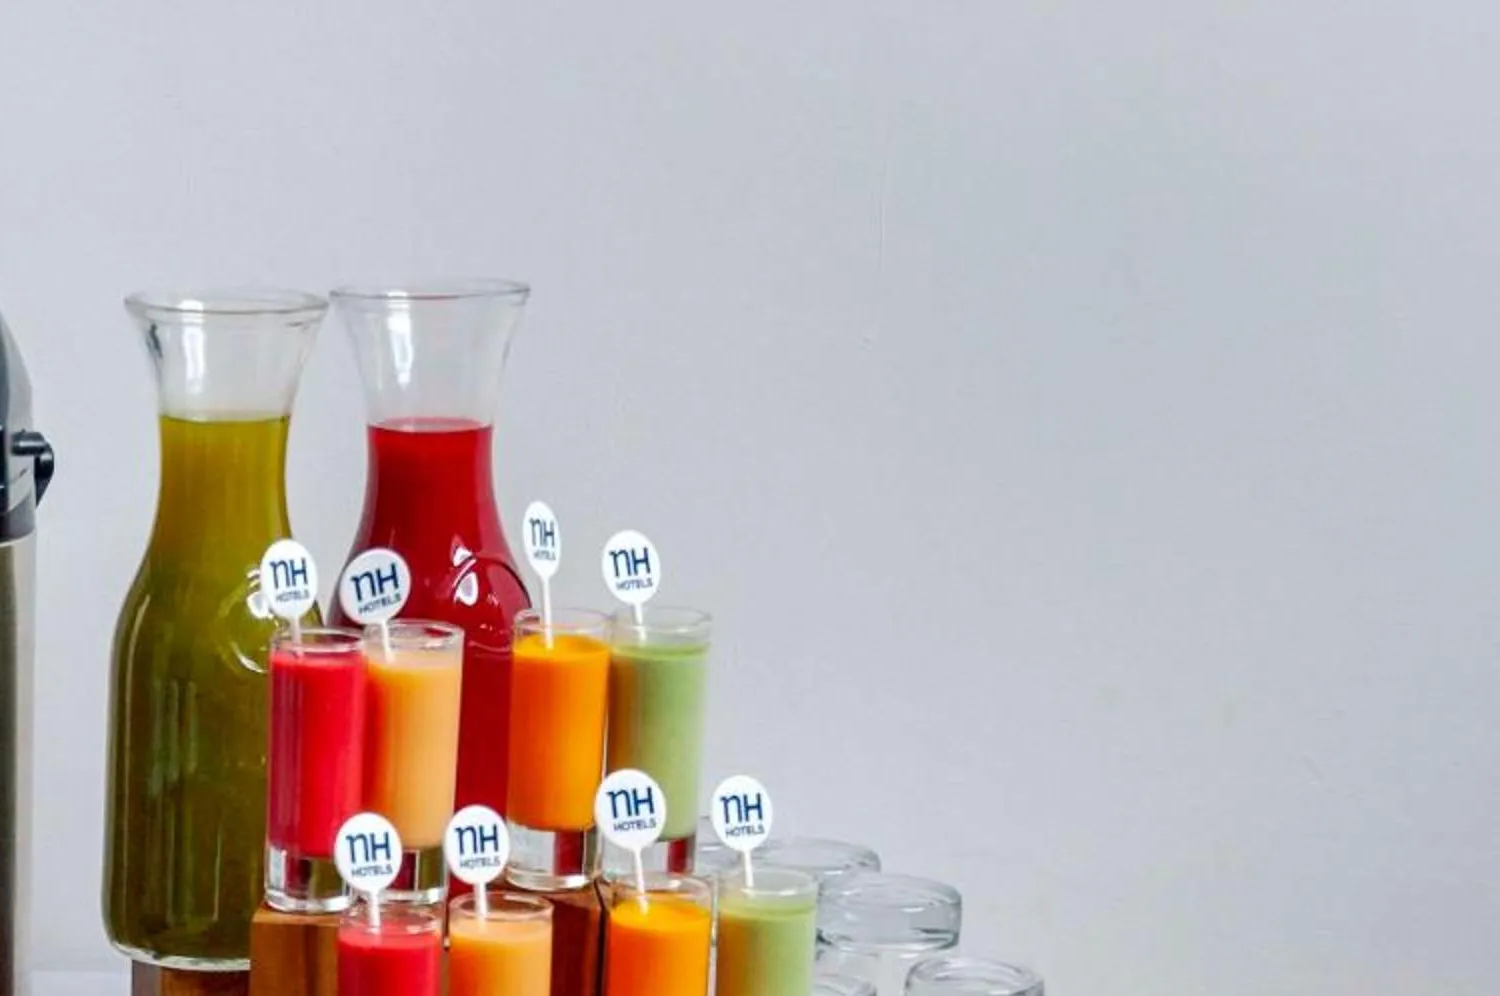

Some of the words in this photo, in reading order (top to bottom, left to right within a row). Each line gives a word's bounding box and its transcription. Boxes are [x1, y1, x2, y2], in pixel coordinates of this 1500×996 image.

[613, 818, 657, 832] HOTELS
[725, 823, 765, 837] HOTELS
[351, 864, 393, 878] HOTELS
